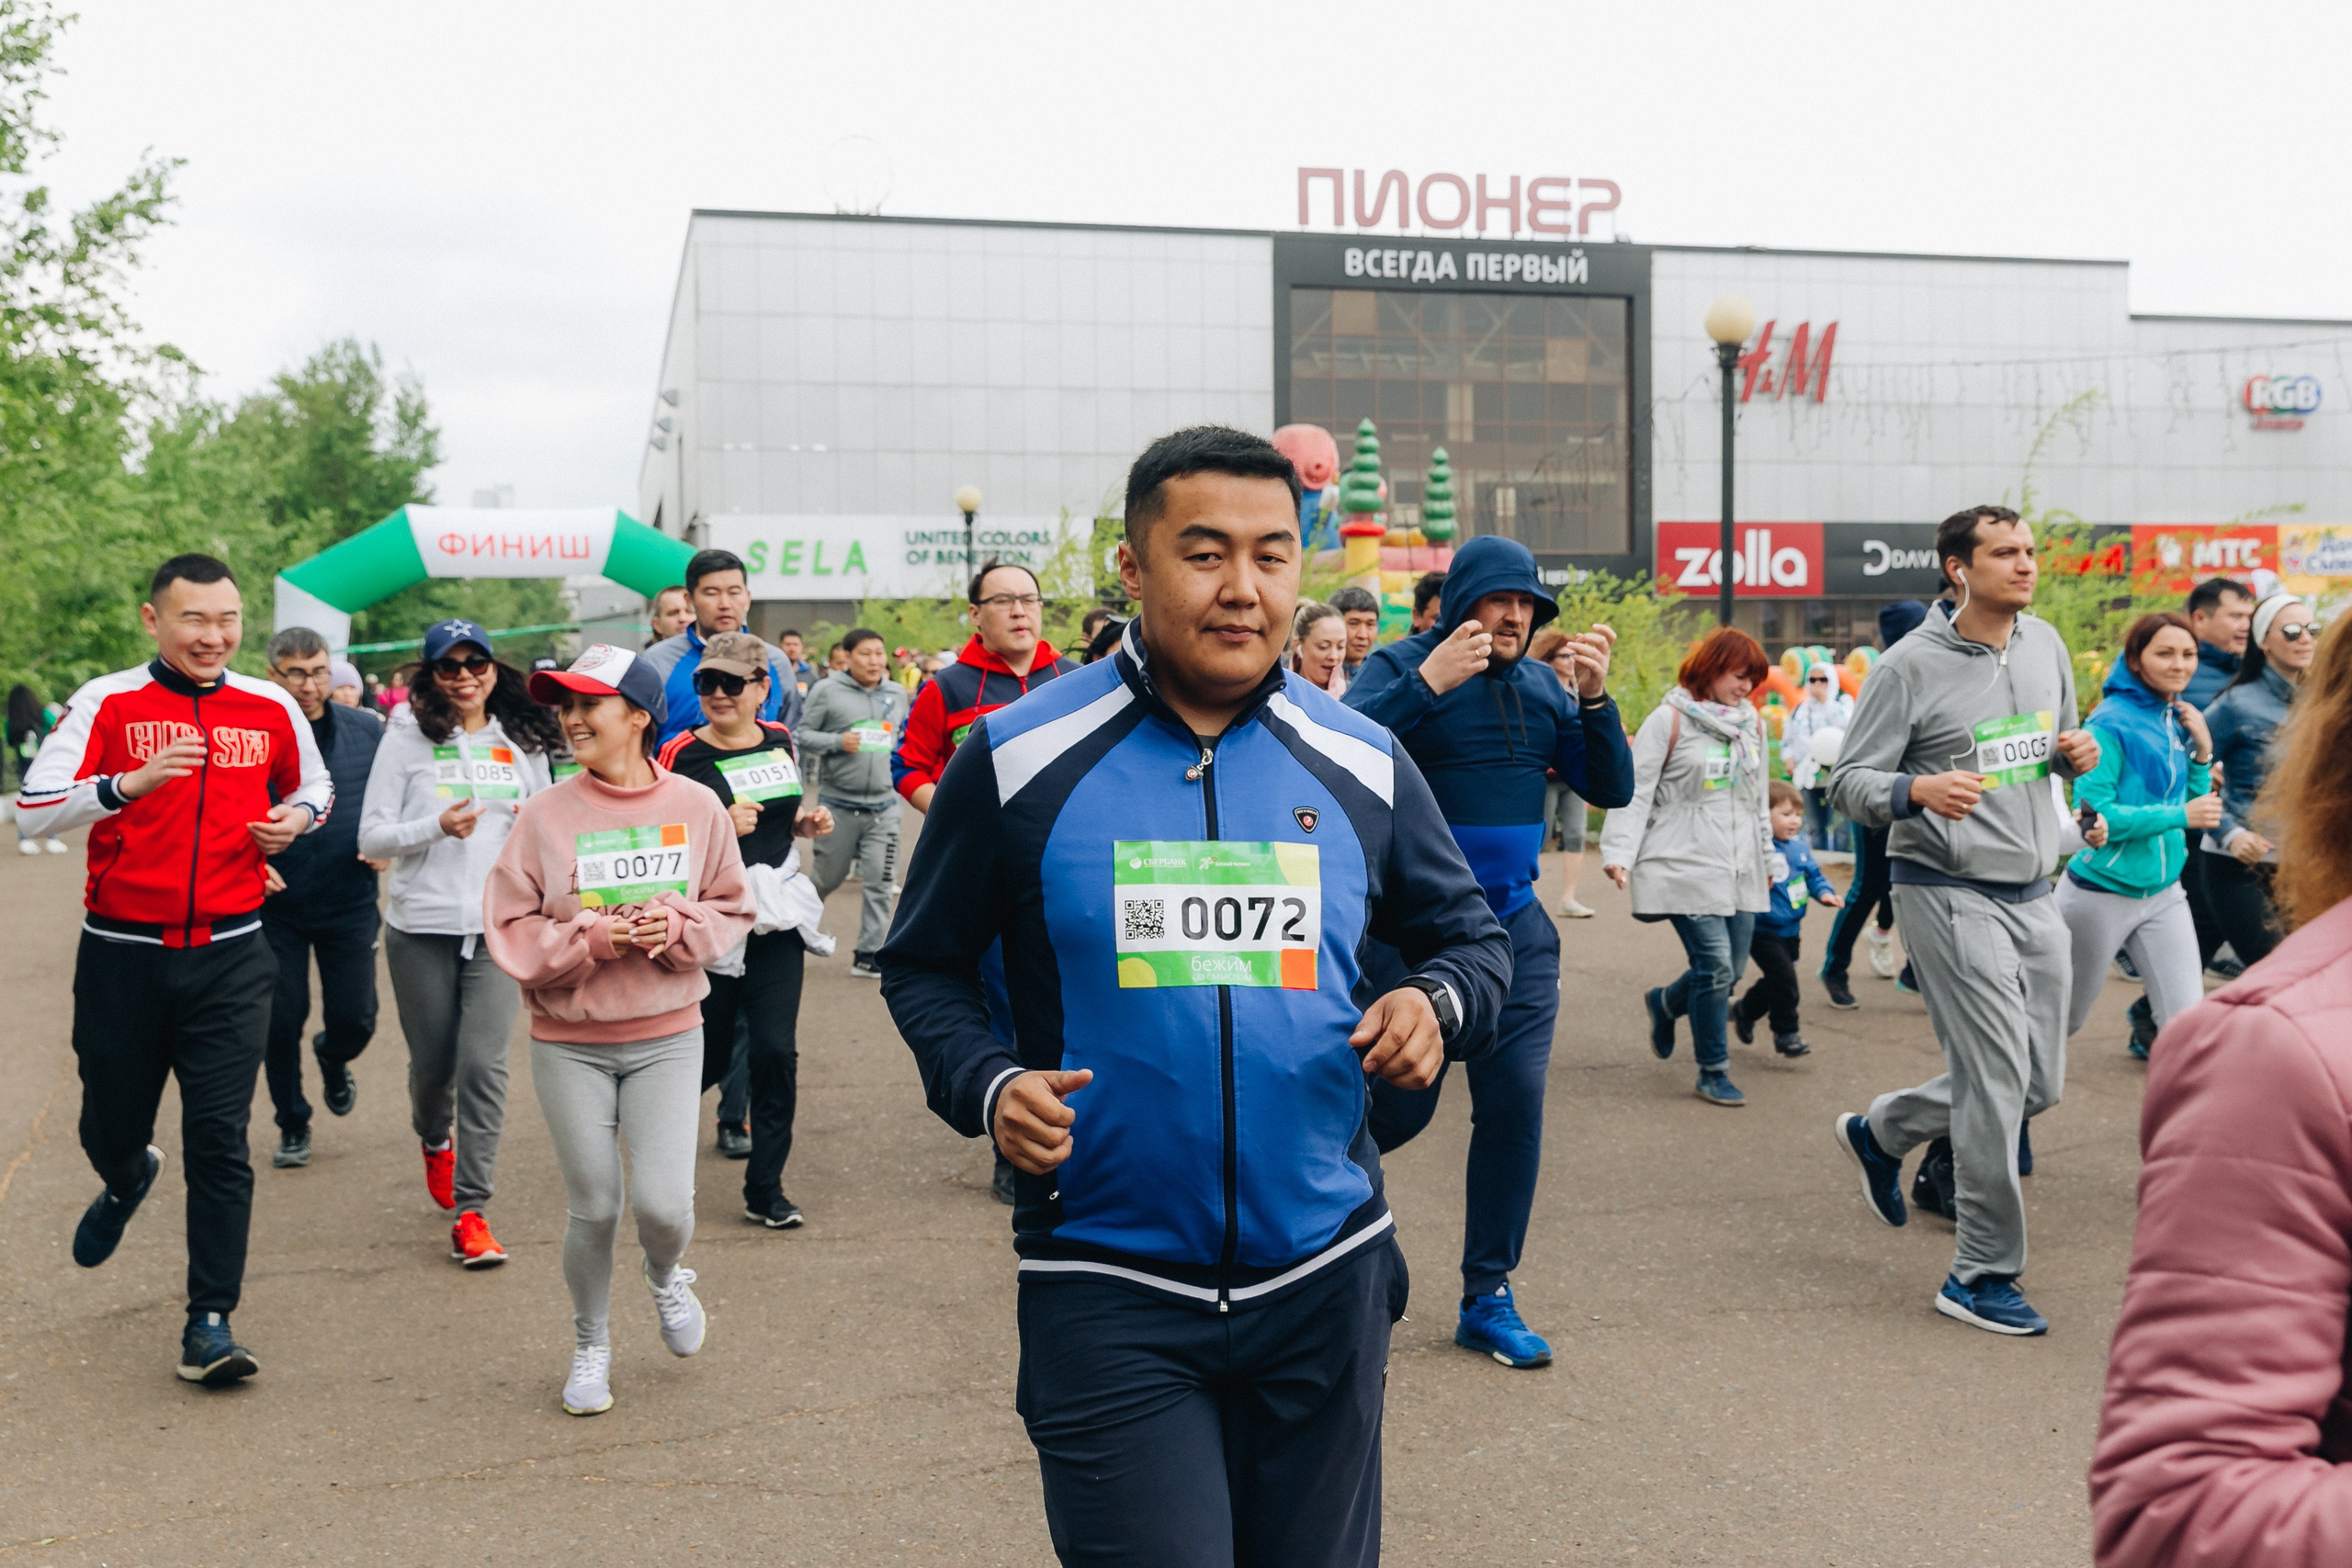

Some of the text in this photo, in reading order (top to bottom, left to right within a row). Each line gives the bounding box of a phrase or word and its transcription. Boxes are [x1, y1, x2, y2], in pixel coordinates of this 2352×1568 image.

[1298, 166, 1622, 235] ПИОНЕР
[1344, 247, 1589, 285] ВСЕГДА ПЕРВЫЙ
[1735, 319, 1838, 404] H&M
[437, 533, 590, 559] ФИНИШ
[978, 531, 1050, 545] COLORS
[2192, 537, 2262, 568] МТС
[746, 540, 868, 576] SELA
[906, 550, 929, 565] OF
[1675, 528, 1808, 587] zolla
[749, 764, 792, 784] 0151
[614, 852, 682, 879] 0077
[1181, 896, 1307, 942] 0072
[1191, 955, 1252, 972] бежим
